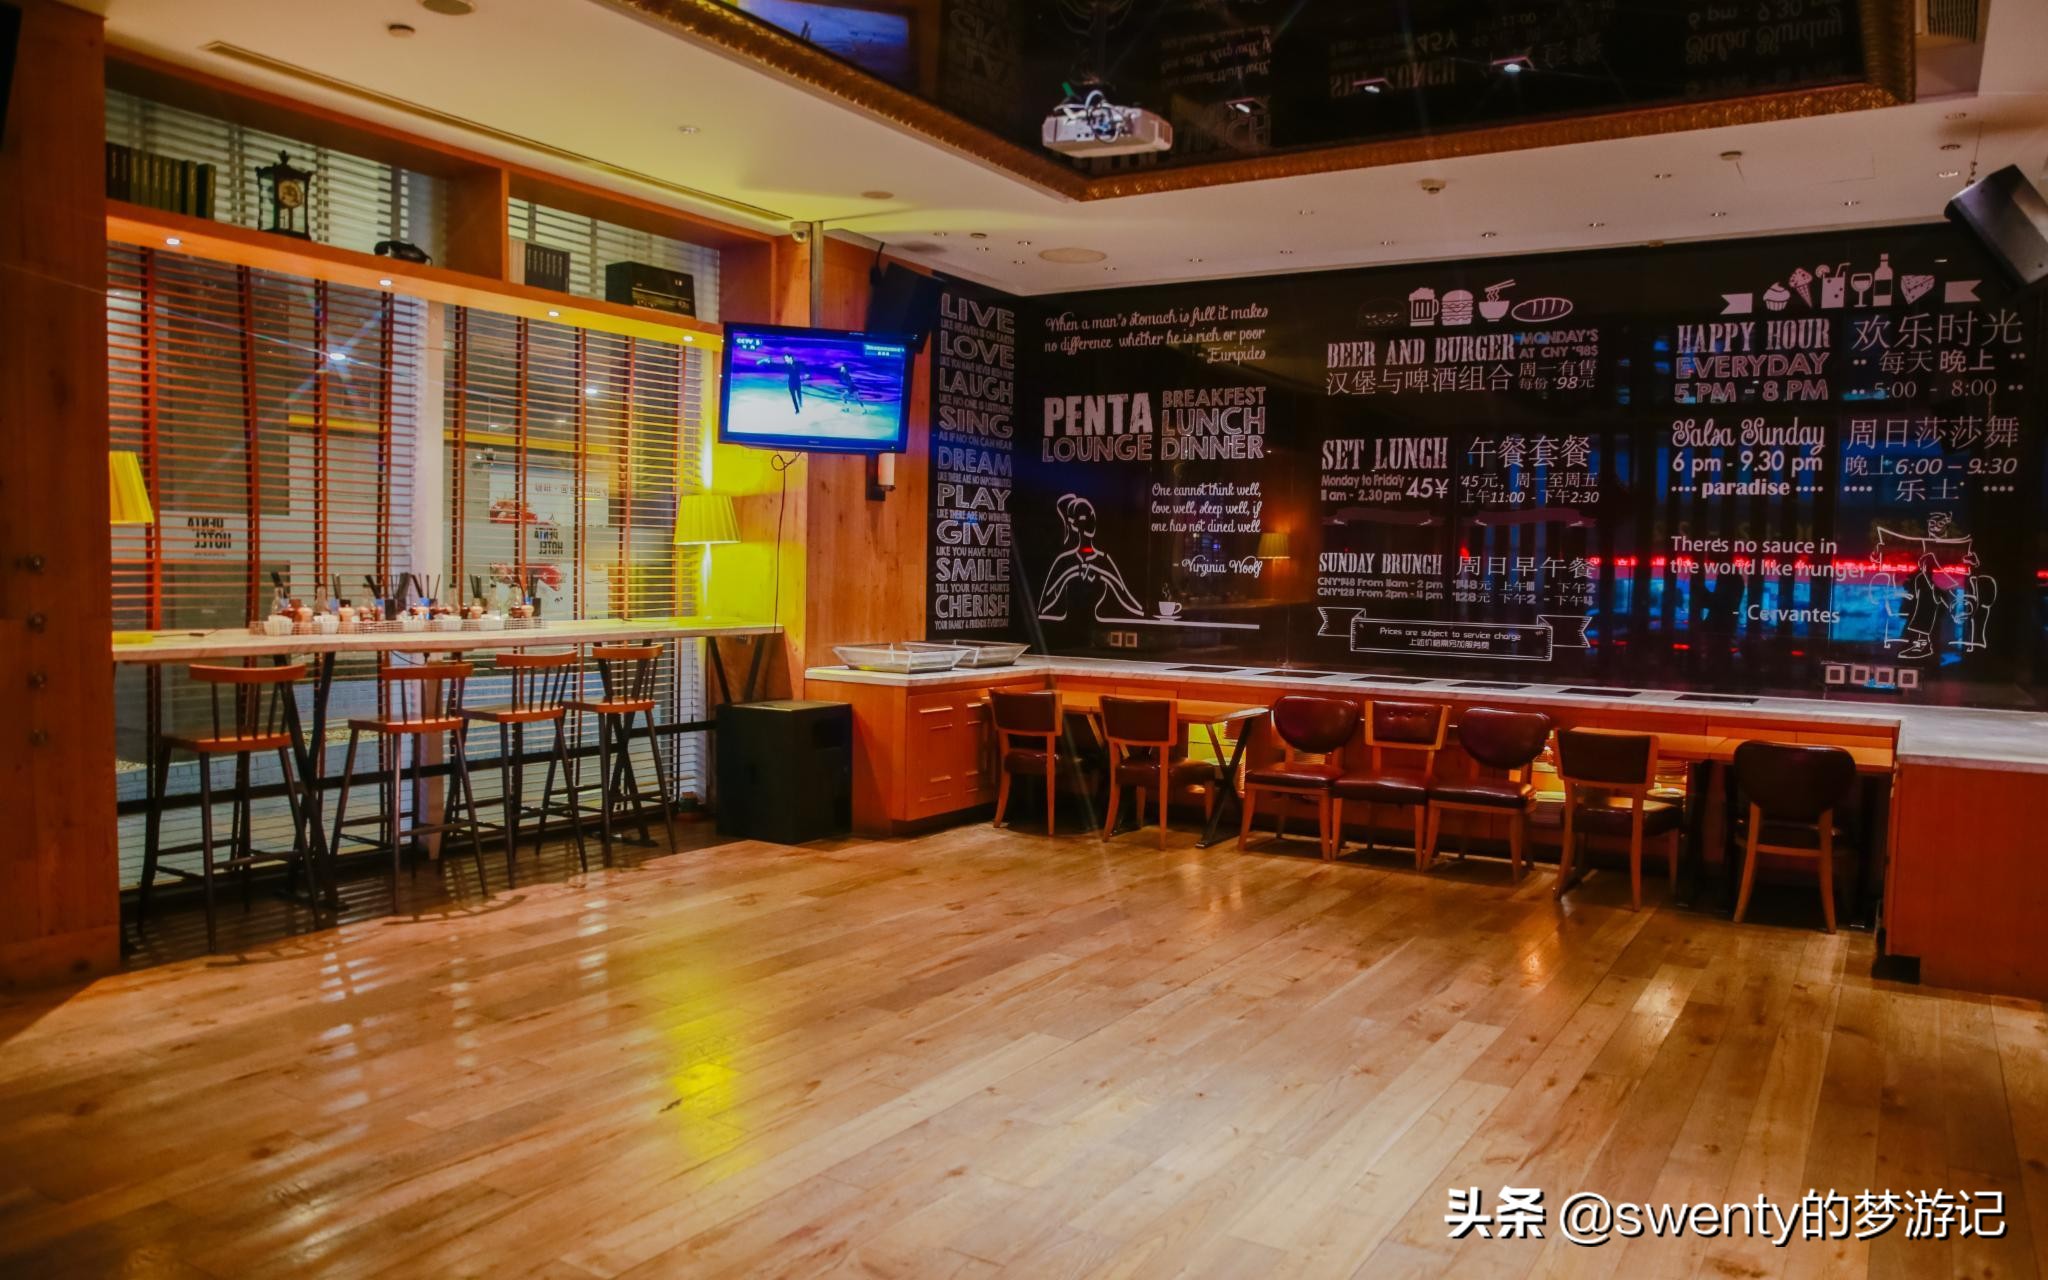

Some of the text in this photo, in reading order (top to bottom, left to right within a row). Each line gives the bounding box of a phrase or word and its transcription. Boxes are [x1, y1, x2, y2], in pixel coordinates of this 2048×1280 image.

[941, 293, 1015, 335] LIVE
[1045, 302, 1269, 331] When a man's stomach is full it makes
[1044, 327, 1266, 356] no difference whether he is rich or poor
[1519, 329, 1599, 345] MONDAY'S
[1676, 318, 1831, 353] HAPPY HOUR
[1851, 308, 2023, 352] 欢乐时光
[940, 330, 1015, 369] LOVE
[1207, 345, 1267, 366] Euripides
[1327, 333, 1516, 368] BEER AND BURGER
[1519, 347, 1536, 359] AT
[1540, 346, 1568, 358] CNY
[1878, 348, 1996, 375] 每天晚上
[1675, 352, 1830, 380] EVERYDAY
[939, 367, 1014, 404] LAUGH
[1326, 363, 1515, 396] 汉堡与啤酒组合
[1674, 378, 1829, 404] 5 PM 8 PM
[1874, 379, 1998, 399] 5:00 8:00
[1162, 386, 1267, 408] BREAKFEST
[939, 405, 1013, 438] SING
[1043, 392, 1153, 437] PENTA
[1161, 407, 1266, 436] LUNCH
[1672, 416, 1826, 456] Salsa Sunday
[1846, 415, 2020, 451] 周日莎莎舞
[1042, 434, 1153, 462] LOUNGE
[1160, 435, 1265, 460] DINNER
[1321, 437, 1449, 470] SET LUNCH
[1467, 434, 1593, 468] 午餐套餐
[938, 446, 1012, 477] DREAM
[1672, 450, 1823, 478] 6 pm 9.30 pm
[1845, 455, 2018, 476] 晚上6:00 9:30
[1151, 482, 1262, 498] One cannot think well,
[1321, 473, 1405, 489] Monday to Friday
[1701, 478, 1791, 499] paradise
[1894, 478, 1960, 502] 乐土
[938, 483, 1011, 511] PLAY
[1328, 491, 1347, 501] am
[1358, 489, 1382, 501] 2.30
[1383, 491, 1402, 503] pm
[1460, 489, 1600, 504] 上午11:00 下午2:30
[1151, 500, 1263, 519] love well, sleep well, if
[937, 520, 1011, 546] GIVE
[1151, 519, 1262, 532] one has not dined well
[936, 546, 950, 556] LIKE
[952, 547, 967, 557] YOU
[968, 547, 986, 557] HAVE
[1734, 539, 1757, 553] no
[1762, 540, 1815, 554] sauce
[1820, 538, 1837, 554] in
[936, 557, 1010, 582] SMILE
[1181, 554, 1263, 578] Virginia Woolf
[1318, 552, 1443, 576] SUNDAY BRUNCH
[1456, 555, 1597, 579] 周日早午餐
[1670, 559, 1865, 581] the world like hunger
[951, 583, 970, 593] YOUR
[1356, 588, 1383, 598] From
[1384, 589, 1408, 600] 2pm
[1425, 592, 1443, 601] pm
[1357, 578, 1384, 588] From
[1416, 580, 1424, 589] 2
[1425, 581, 1443, 590] pm
[936, 594, 1009, 618] CHERISH
[1747, 604, 1841, 624] Cervantes
[1379, 627, 1521, 642] Prices are subject to service charge
